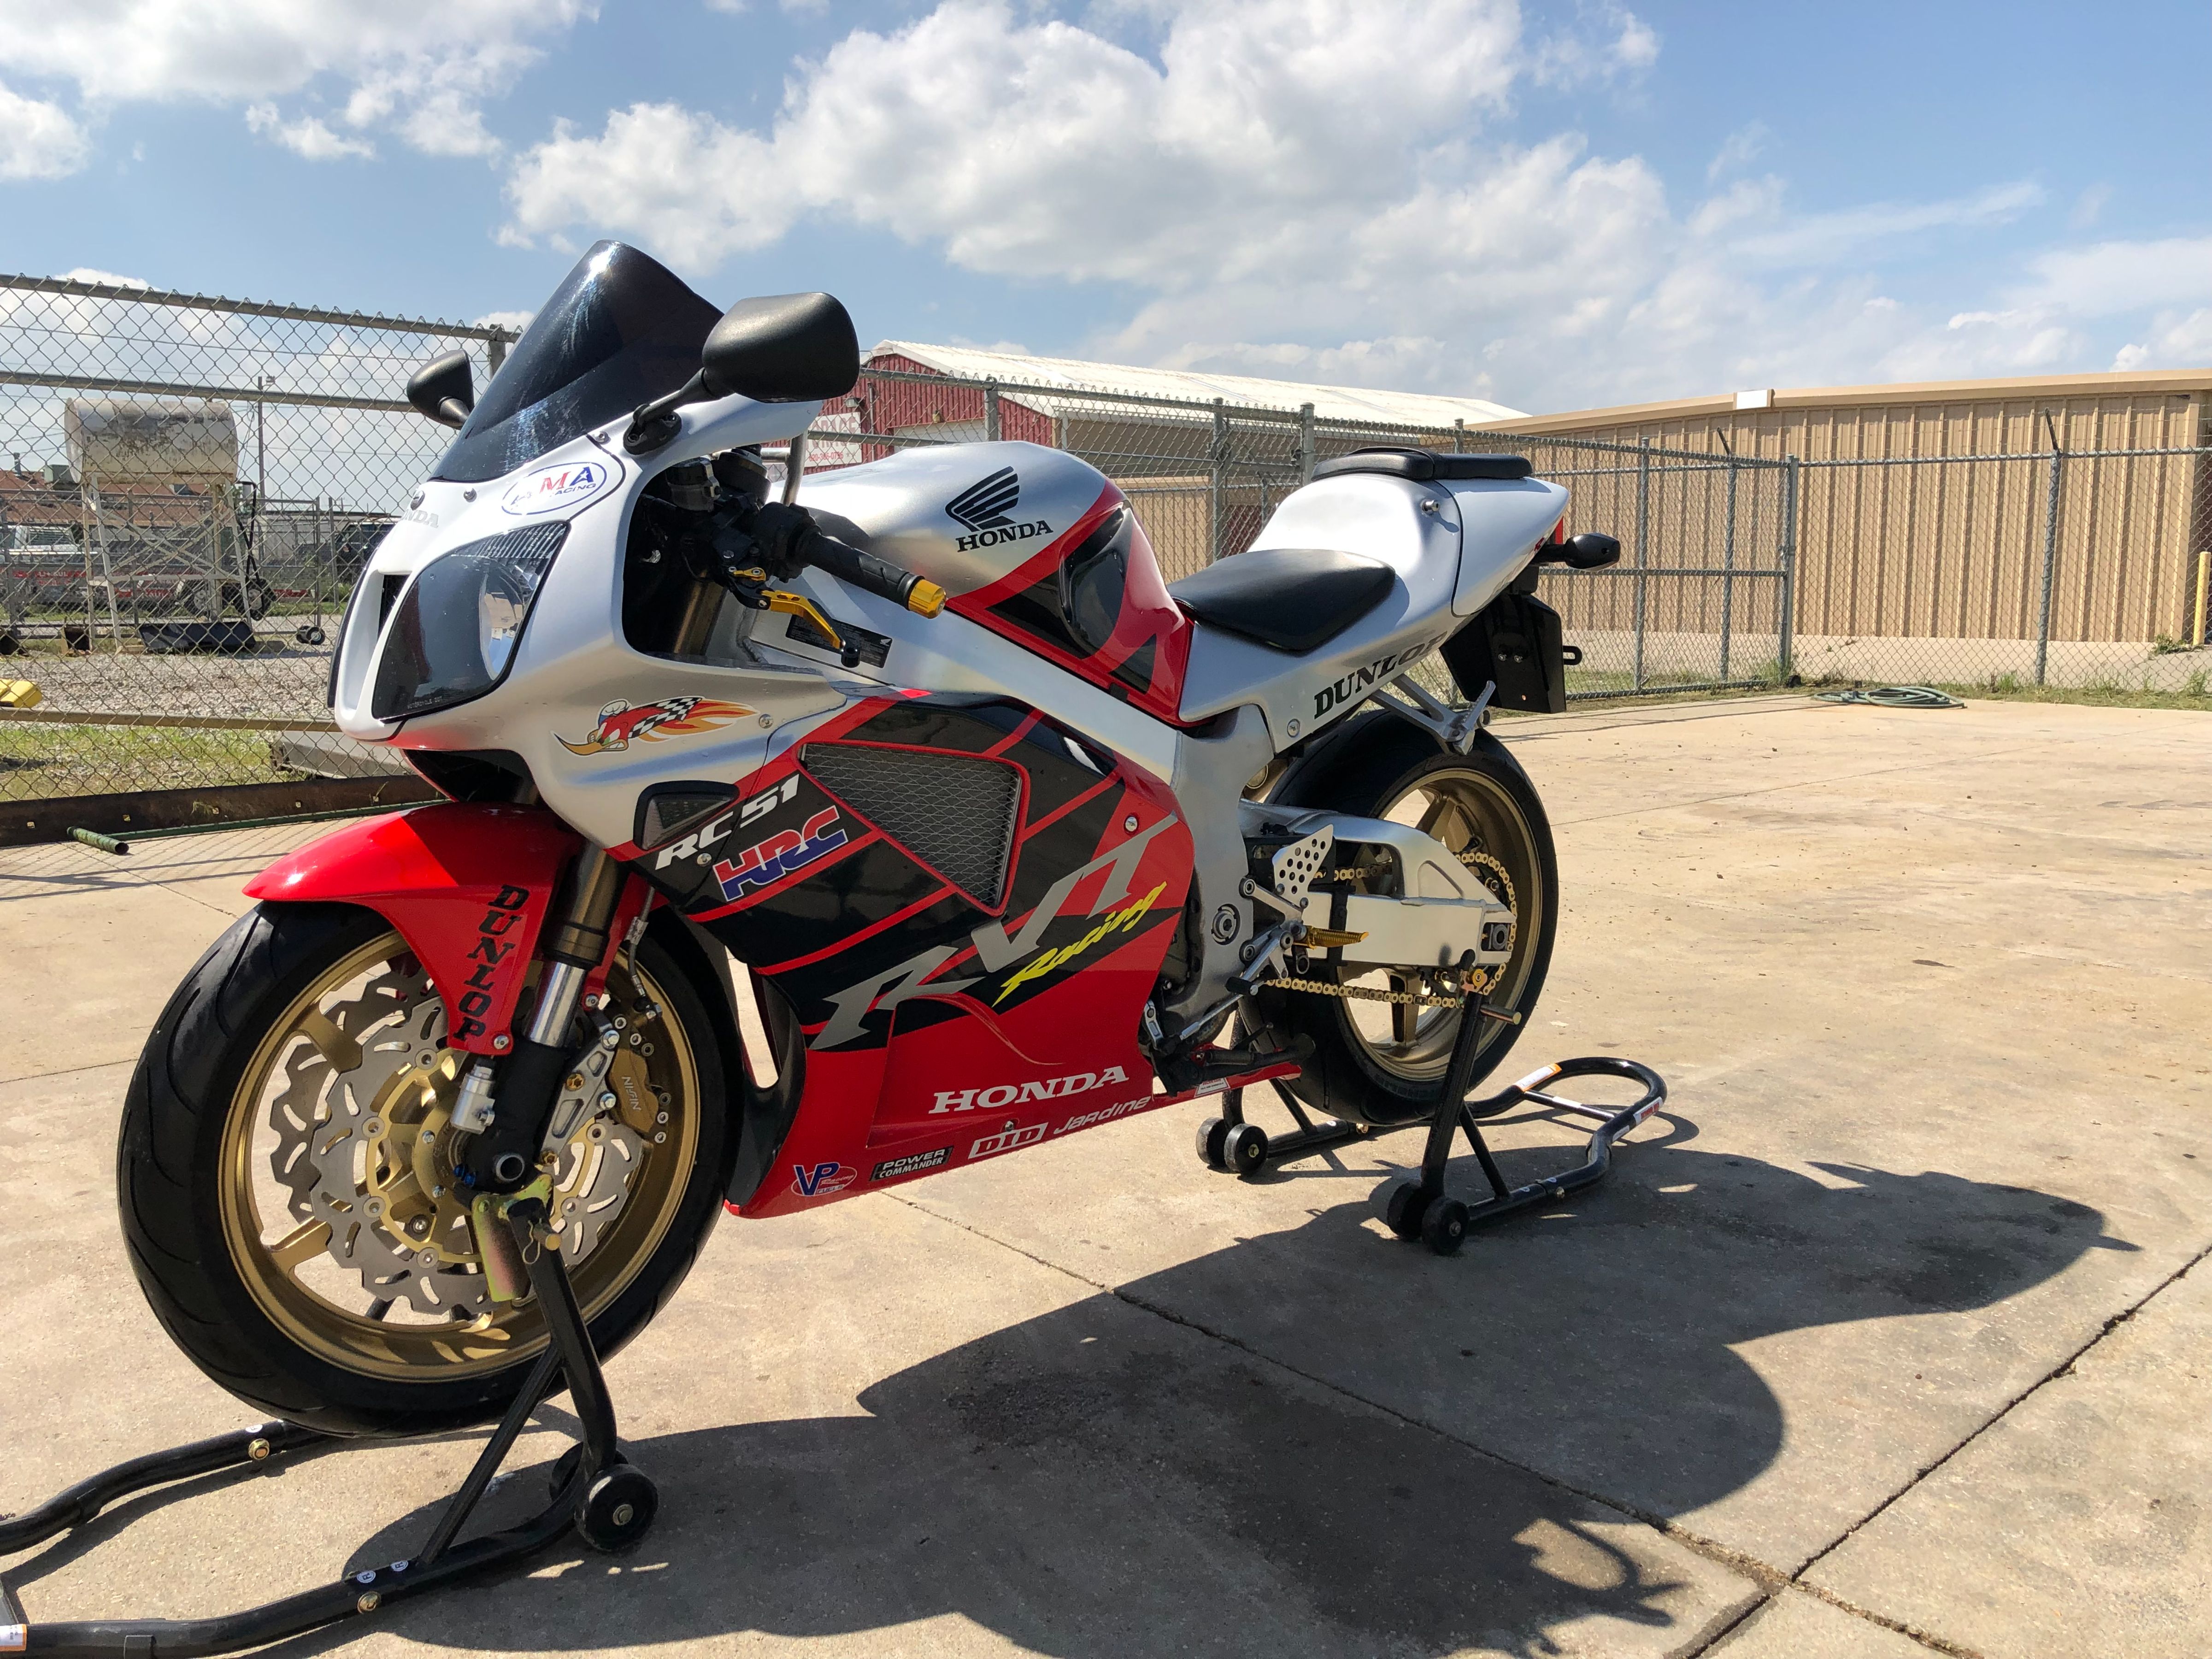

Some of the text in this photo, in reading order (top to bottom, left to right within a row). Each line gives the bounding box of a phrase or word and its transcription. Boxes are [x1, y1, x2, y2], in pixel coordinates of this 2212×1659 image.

[550, 483, 596, 497] ACING
[955, 520, 1054, 553] HONDA
[712, 805, 849, 902] HRC
[991, 881, 1167, 1008] Racing
[453, 884, 530, 1041] DUNLOP
[928, 1065, 1130, 1114] HONDA
[971, 1124, 1046, 1158] DID
[879, 1157, 944, 1178] COMMANDER
[882, 1149, 946, 1171] POWER
[793, 1162, 840, 1196] VP
